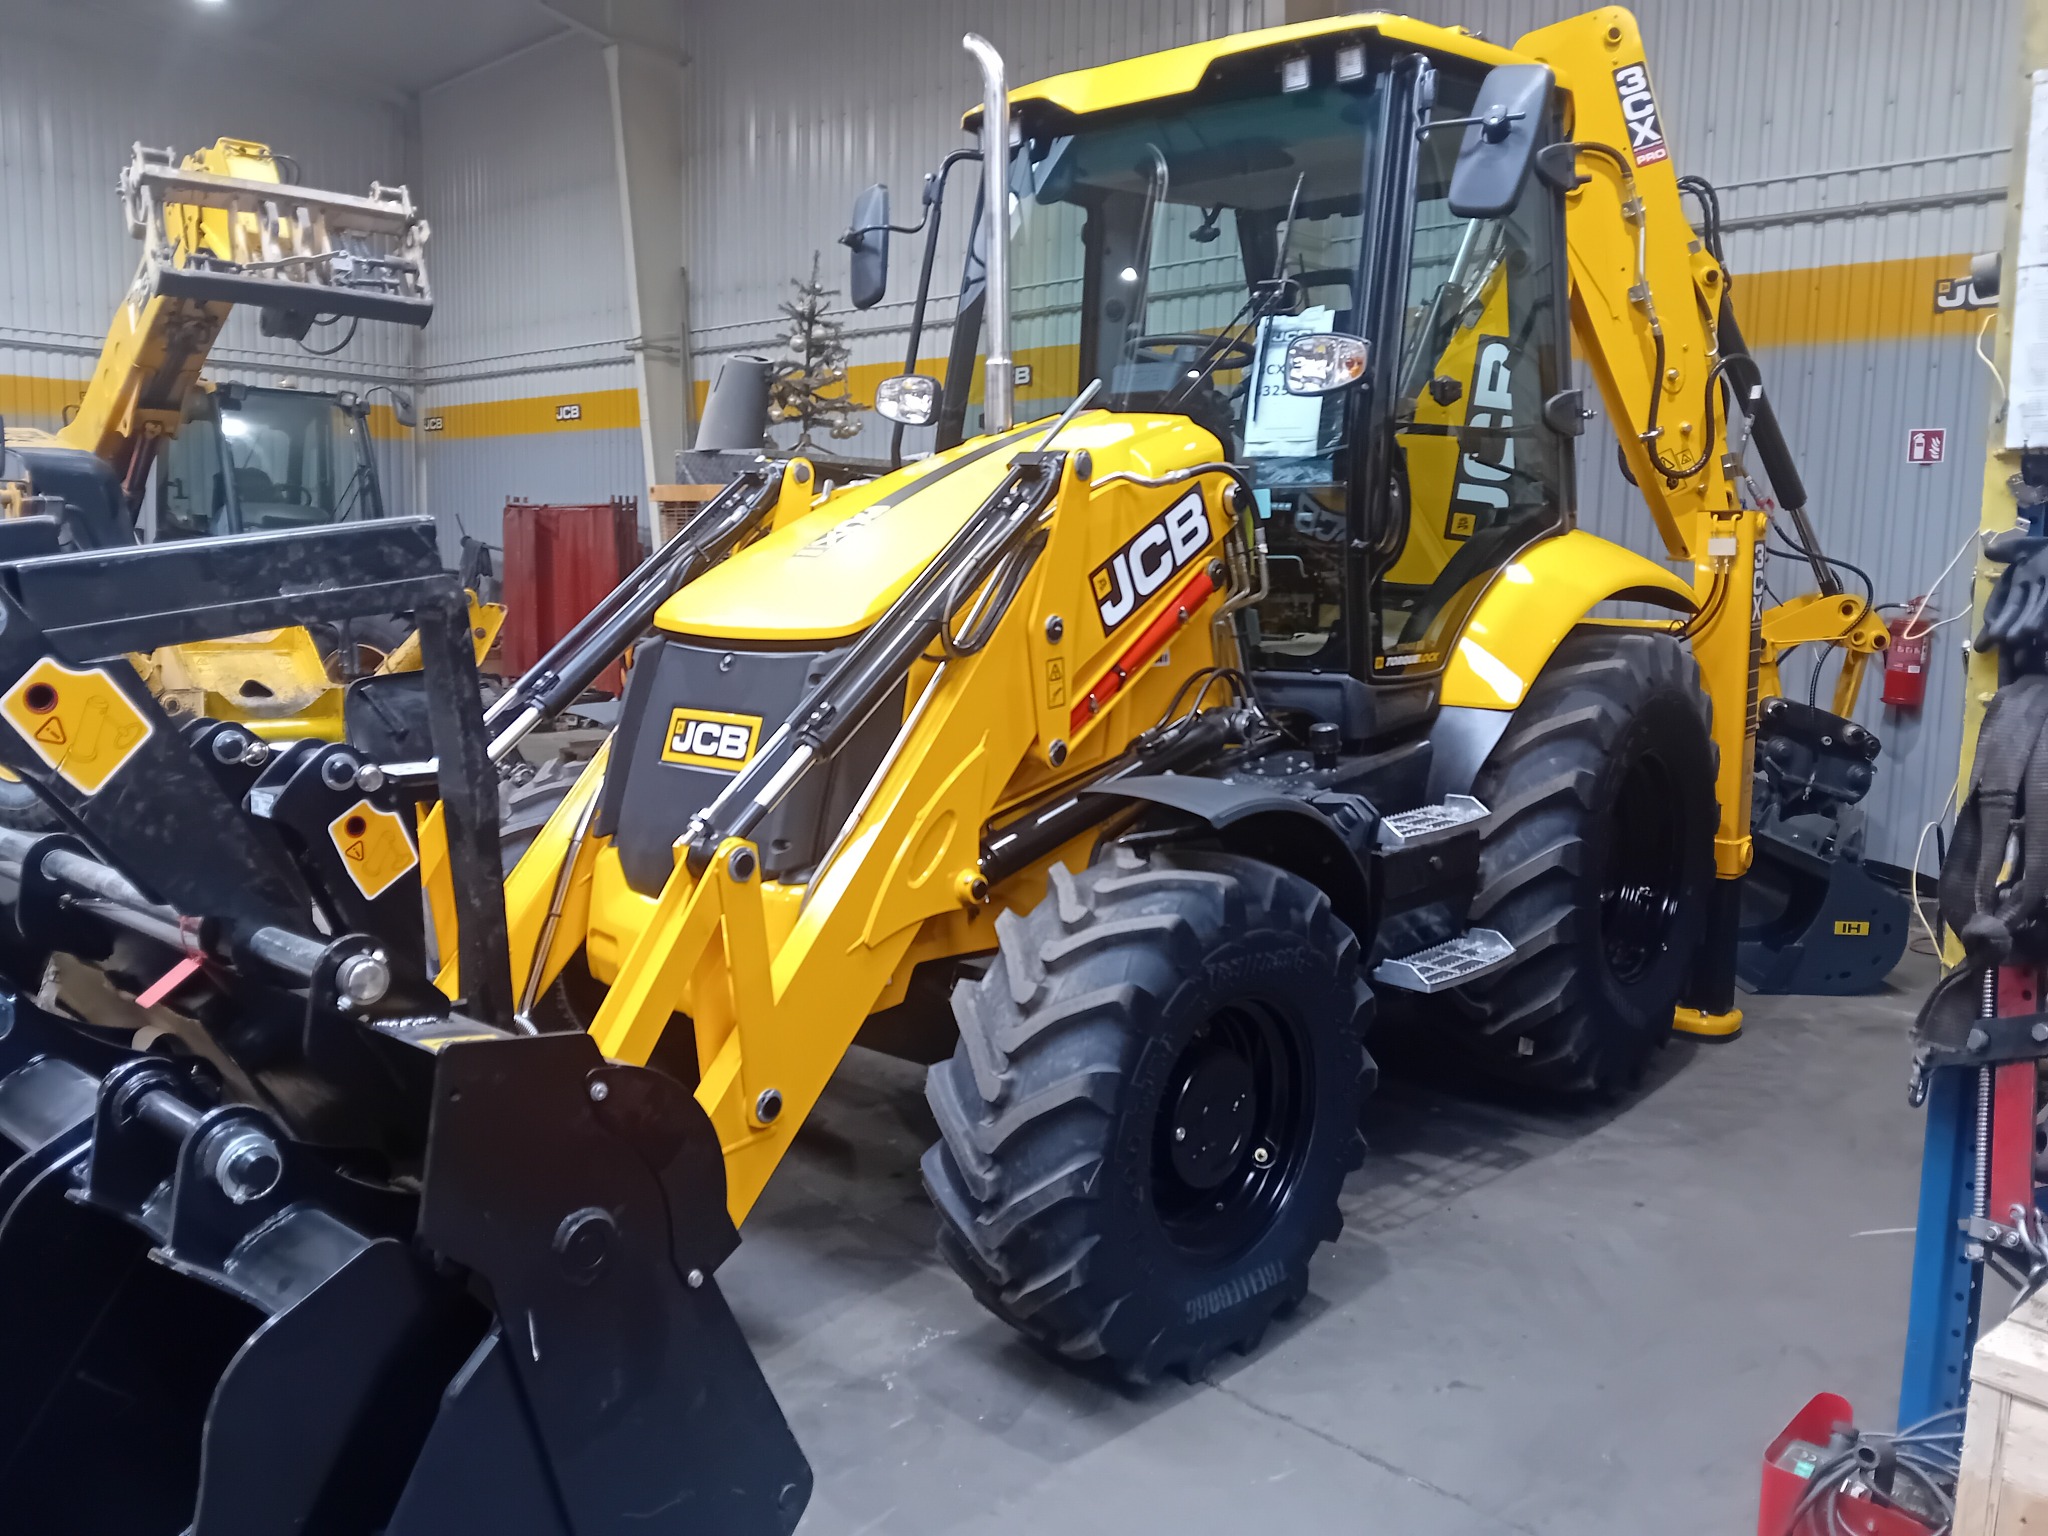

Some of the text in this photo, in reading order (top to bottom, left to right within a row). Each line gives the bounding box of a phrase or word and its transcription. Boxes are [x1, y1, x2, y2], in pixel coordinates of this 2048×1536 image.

[1616, 65, 1661, 147] 3CX
[1636, 148, 1667, 165] PRO
[1262, 364, 1286, 375] CX
[1260, 385, 1289, 397] 325
[556, 405, 580, 420] JCB
[424, 417, 443, 431] JCB
[1100, 492, 1210, 626] JCB
[1751, 543, 1764, 621] 3CX
[671, 720, 750, 760] JCB
